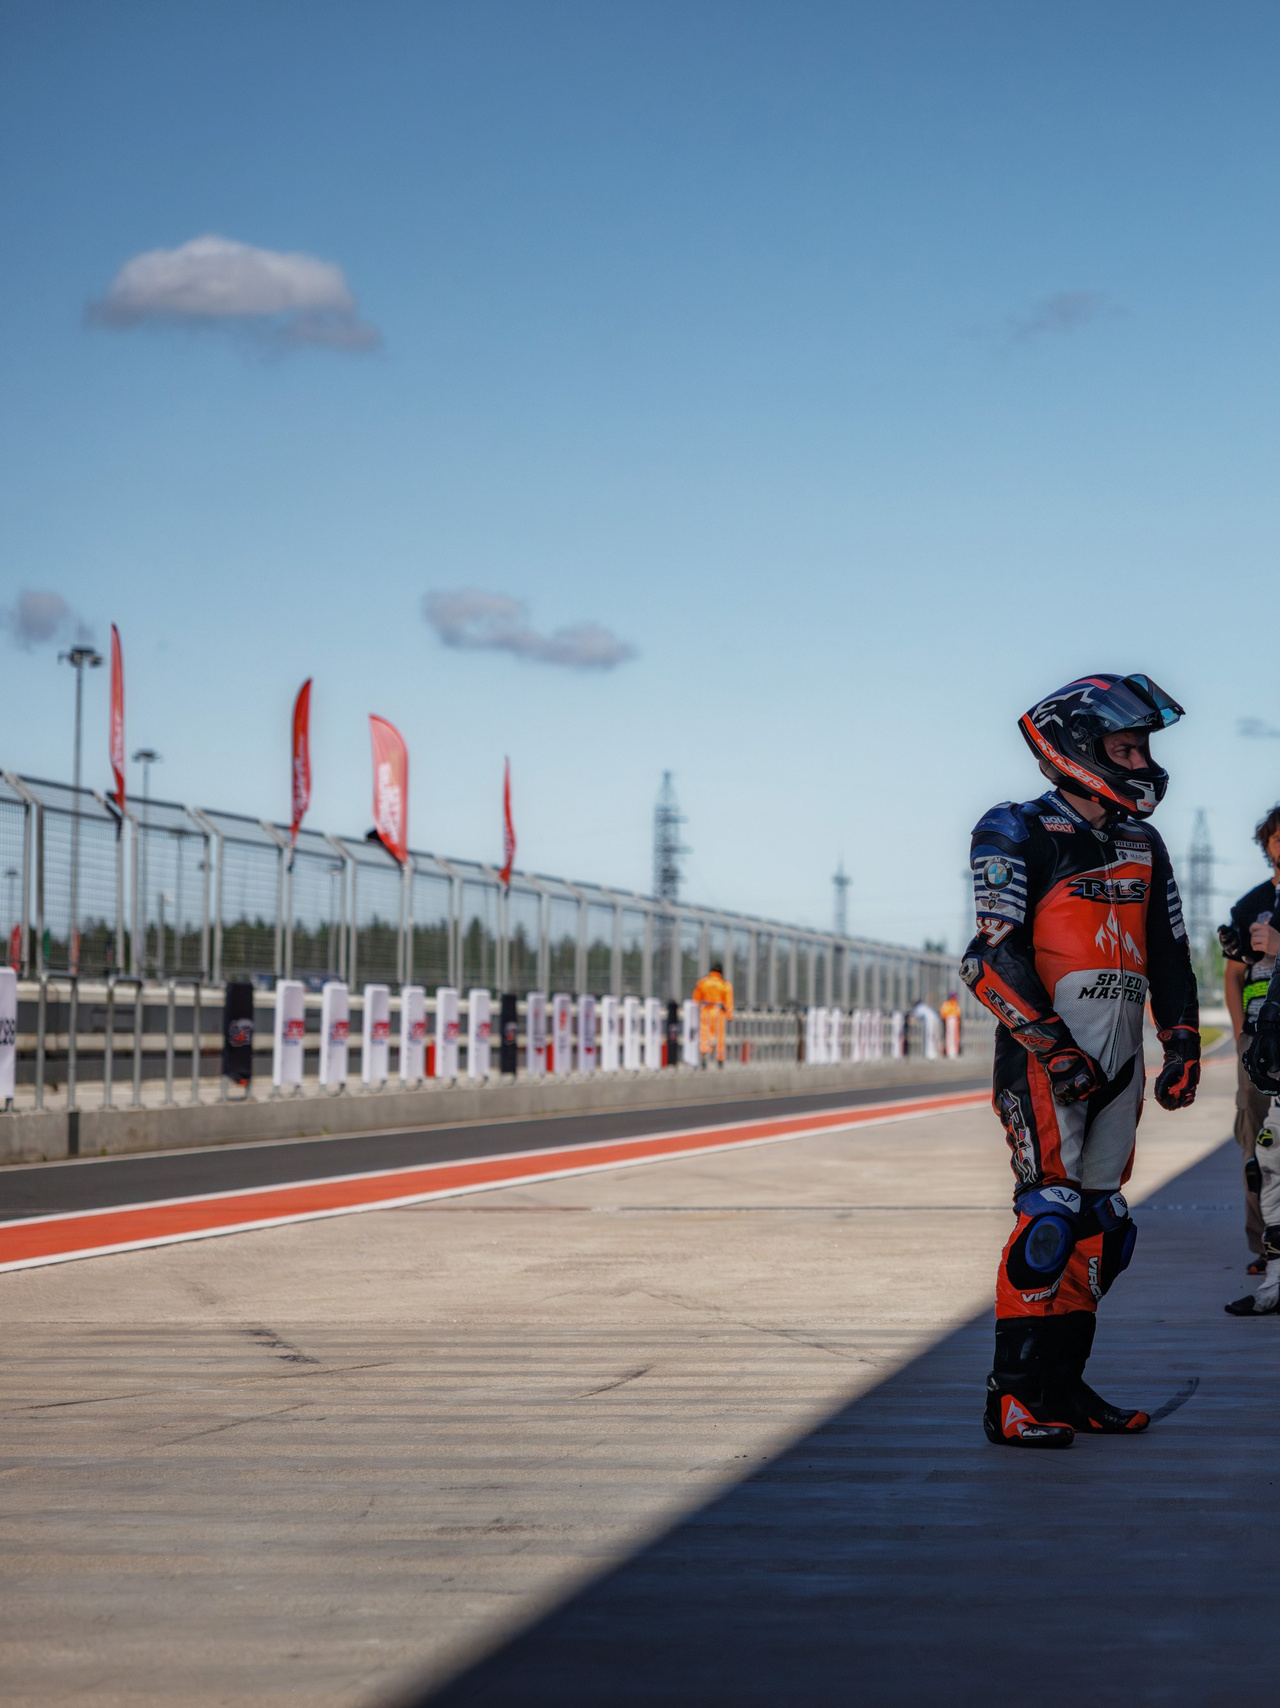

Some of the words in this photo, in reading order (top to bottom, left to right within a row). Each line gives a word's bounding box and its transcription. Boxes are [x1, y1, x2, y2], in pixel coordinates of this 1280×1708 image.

[1047, 794, 1083, 823] VIRCOS
[1045, 823, 1073, 833] MOLY
[1095, 973, 1143, 991] SPEED
[1077, 986, 1146, 1006] MASTERS
